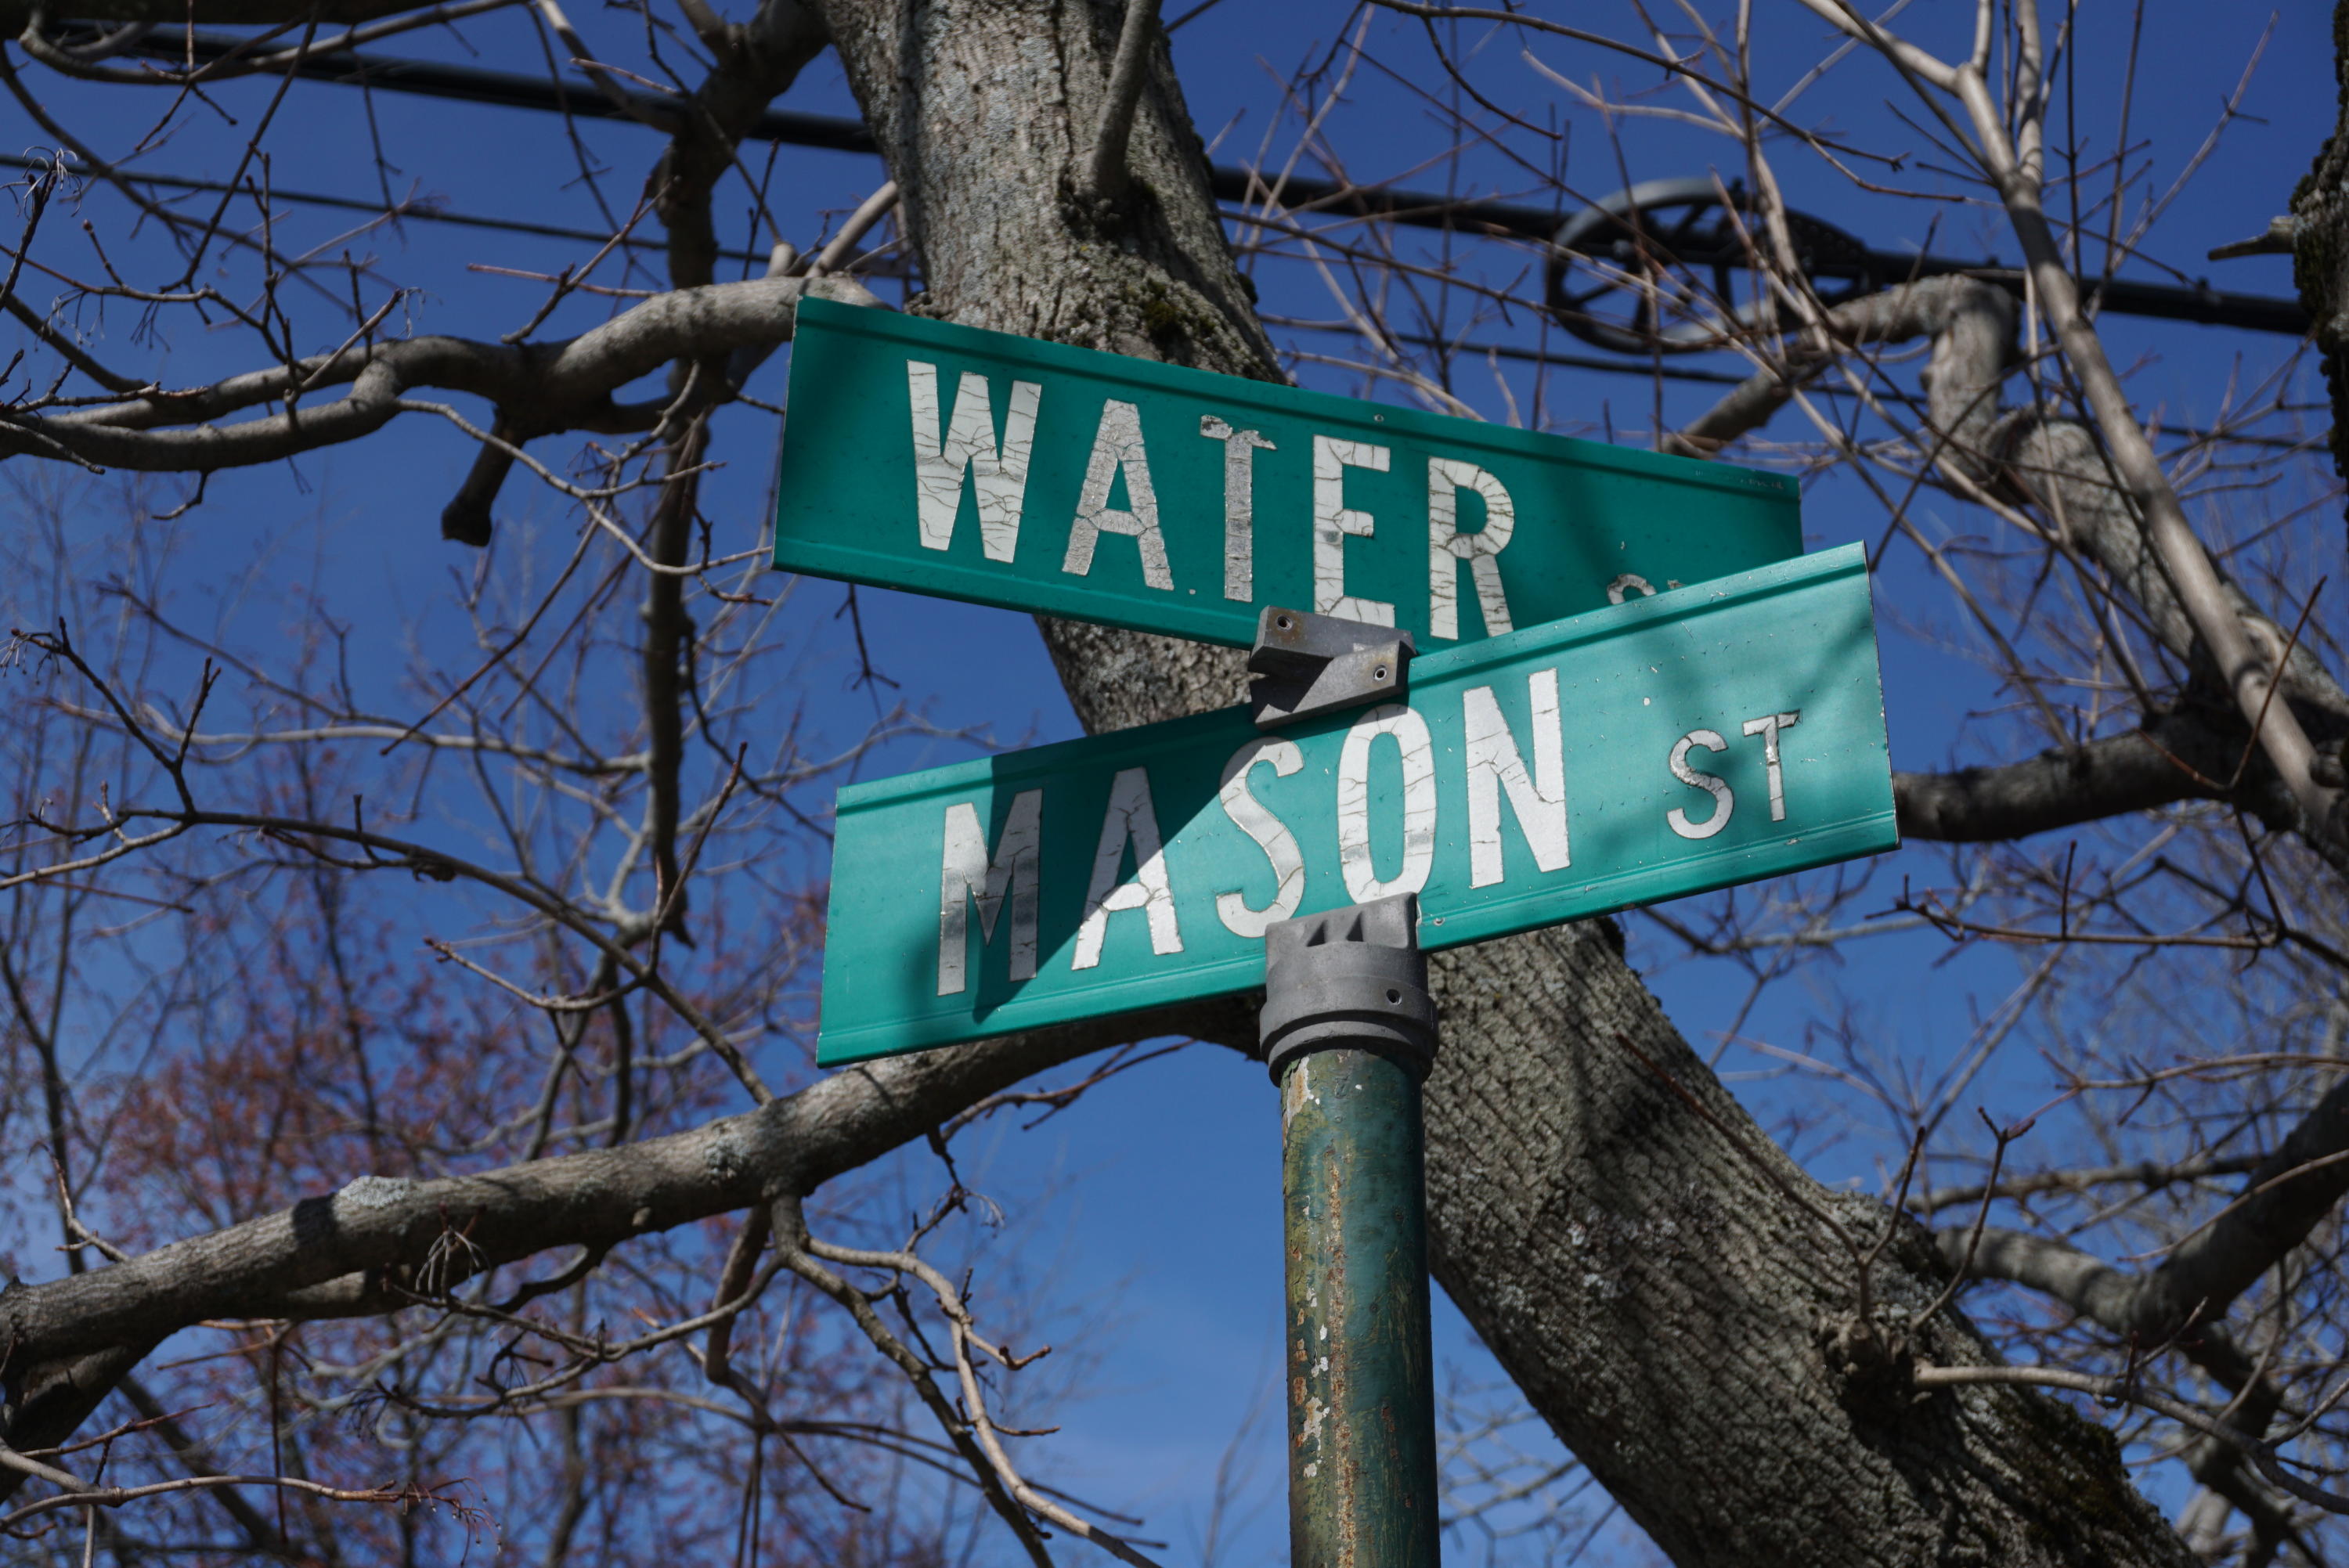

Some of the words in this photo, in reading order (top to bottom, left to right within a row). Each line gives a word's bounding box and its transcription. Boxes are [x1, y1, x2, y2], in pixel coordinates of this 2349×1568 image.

[907, 359, 1515, 641] WATER
[937, 667, 1571, 996] MASON
[1666, 711, 1799, 840] ST
